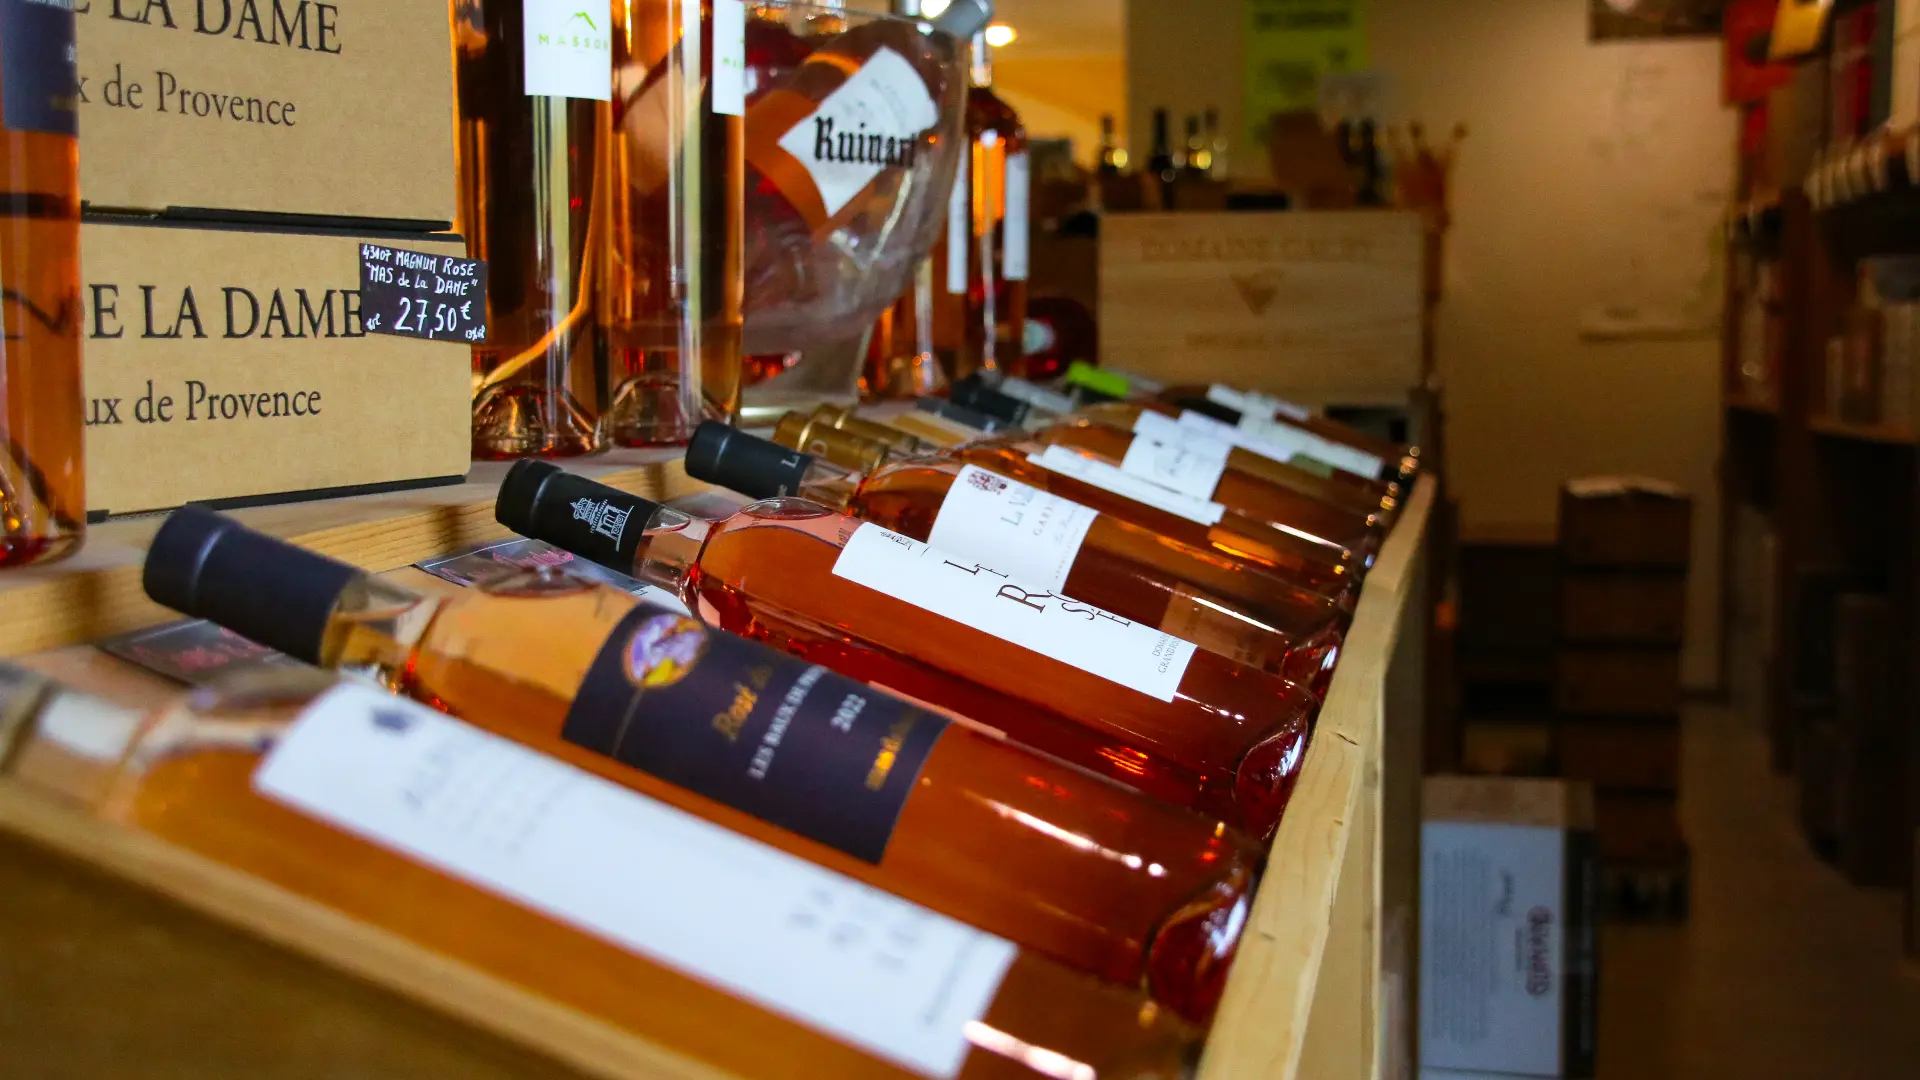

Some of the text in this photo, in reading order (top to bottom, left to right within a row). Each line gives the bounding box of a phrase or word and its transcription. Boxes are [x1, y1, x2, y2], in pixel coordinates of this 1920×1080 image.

[193, 0, 342, 54] DAME
[103, 63, 144, 110] de
[156, 70, 296, 127] Provence
[813, 115, 916, 167] Ruinart
[395, 251, 438, 274] MAGNUM
[398, 272, 410, 288] de
[84, 284, 366, 338] E LA DAME
[134, 379, 174, 424] de
[184, 380, 322, 421] Provence
